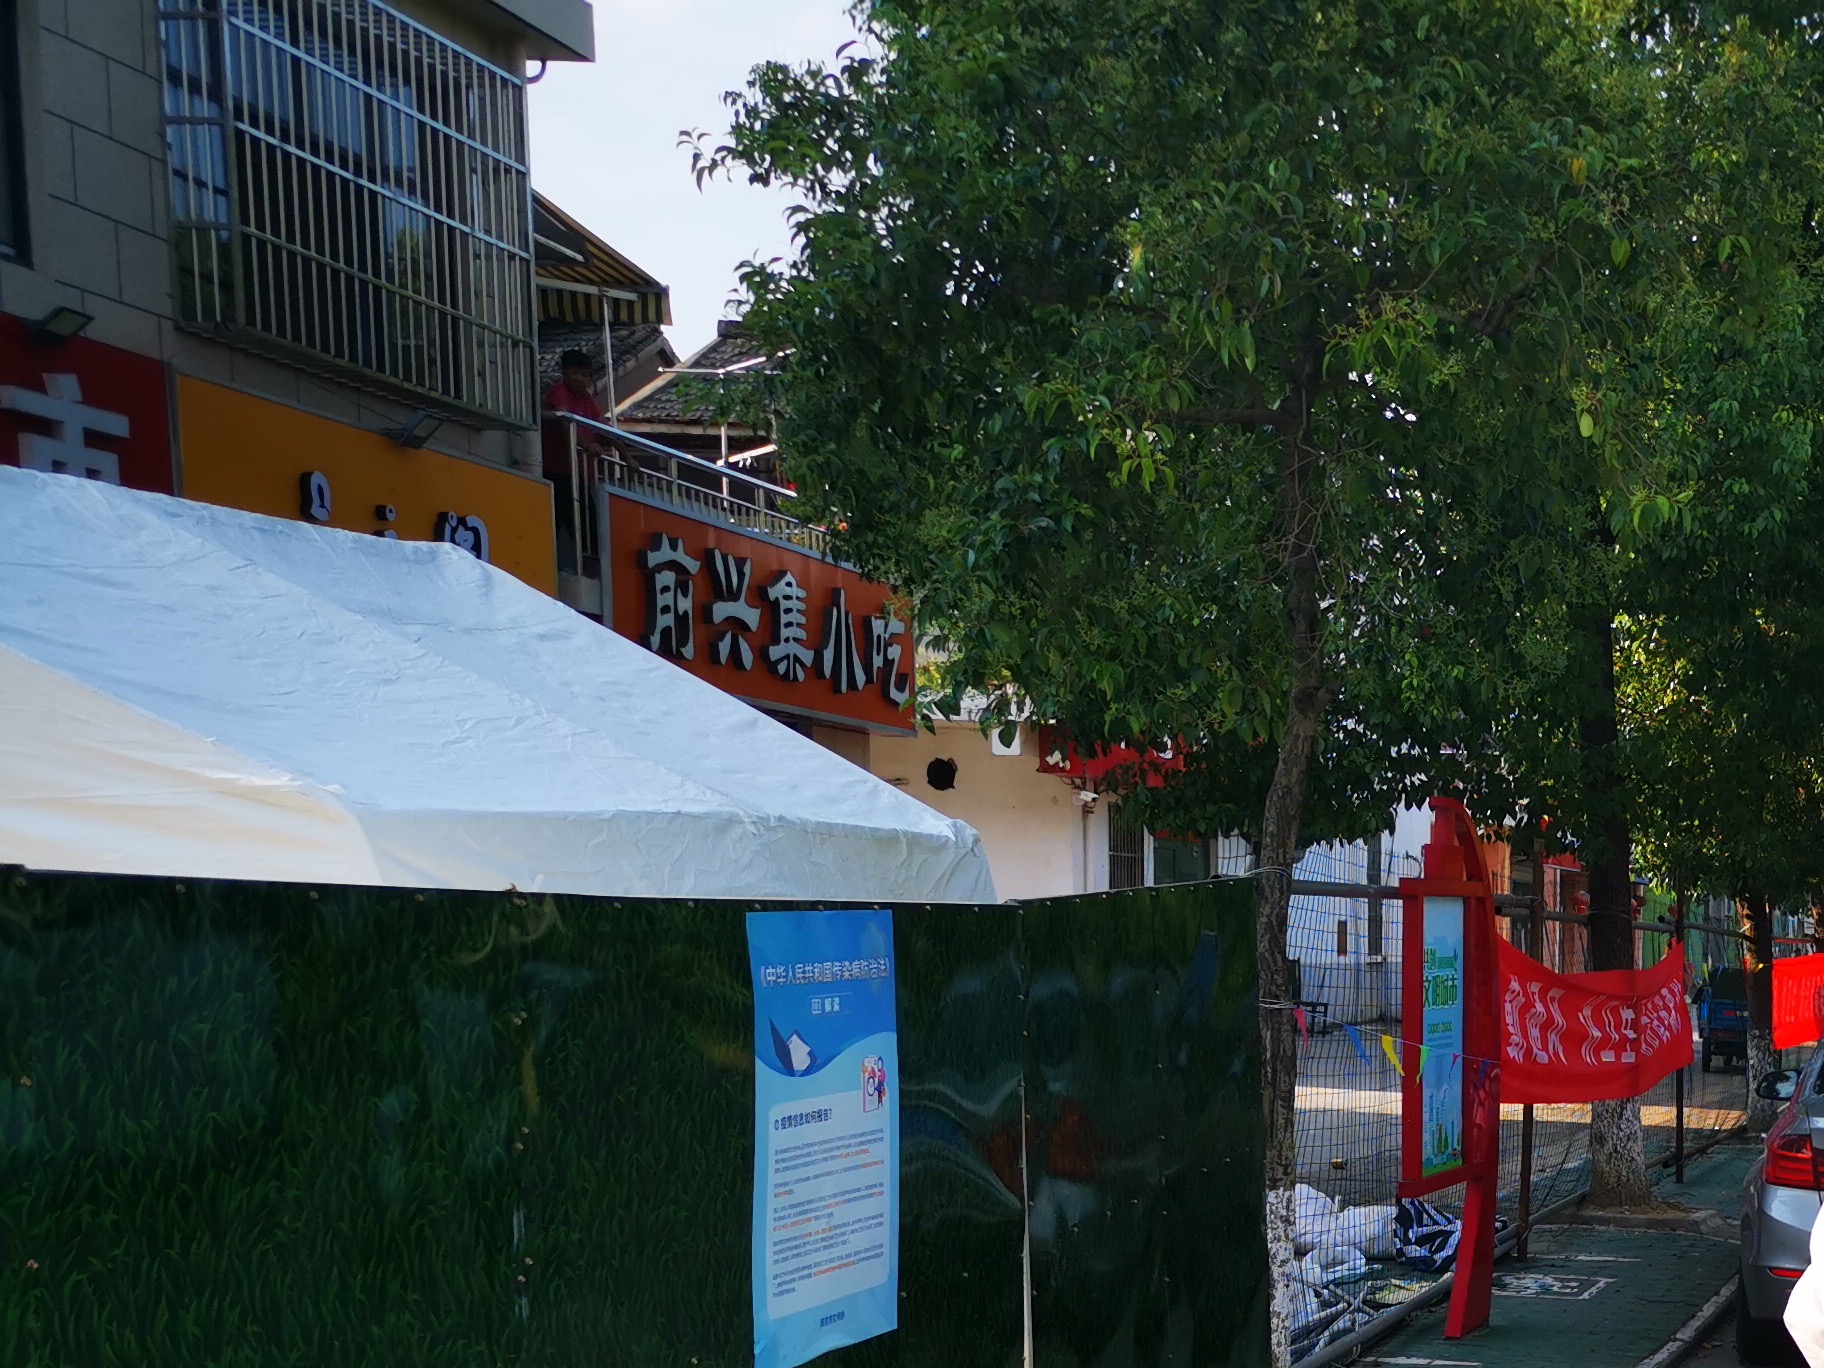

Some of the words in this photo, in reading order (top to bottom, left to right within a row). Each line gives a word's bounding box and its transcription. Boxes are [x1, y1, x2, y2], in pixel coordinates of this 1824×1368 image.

[646, 532, 910, 707] 前兴集小吃
